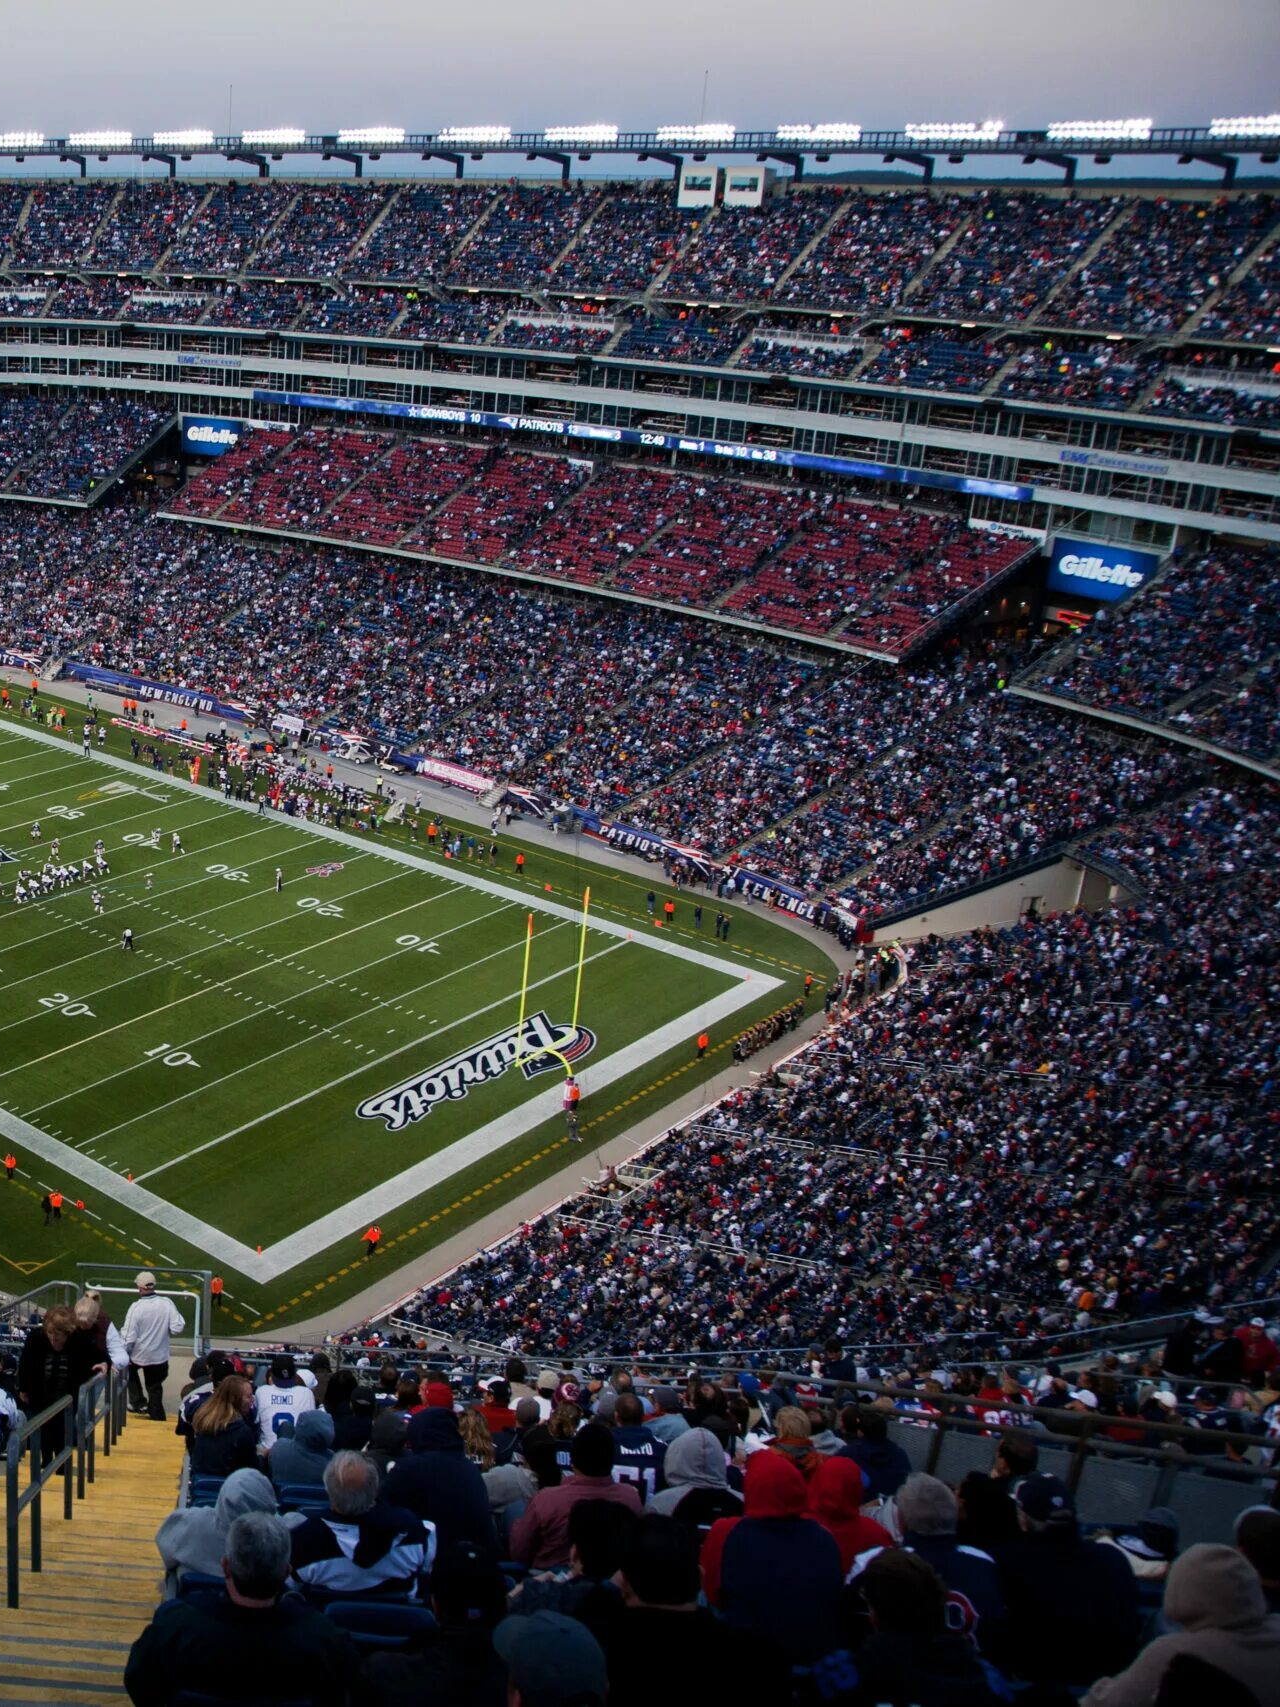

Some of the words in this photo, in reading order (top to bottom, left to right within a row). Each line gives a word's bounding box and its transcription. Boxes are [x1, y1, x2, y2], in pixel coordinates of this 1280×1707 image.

[420, 407, 466, 421] COWBOYS
[470, 413, 481, 423] 10
[187, 426, 238, 444] Gillette
[519, 418, 564, 432] PATRIOTS
[567, 424, 578, 434] 13
[614, 430, 621, 441] 3
[639, 433, 665, 446] 12:49
[699, 441, 705, 452] 1
[736, 446, 748, 457] 10
[1059, 554, 1145, 588] Gillette
[140, 685, 164, 699] NEW
[164, 691, 214, 712] ENGLAND
[47, 805, 85, 820] 50
[205, 864, 248, 883] 30
[297, 897, 342, 918] 20
[395, 934, 437, 954] 10
[38, 992, 88, 1017] 20
[144, 1043, 195, 1067] 10
[355, 1010, 597, 1132] Patriots
[271, 1394, 294, 1406] ROMO
